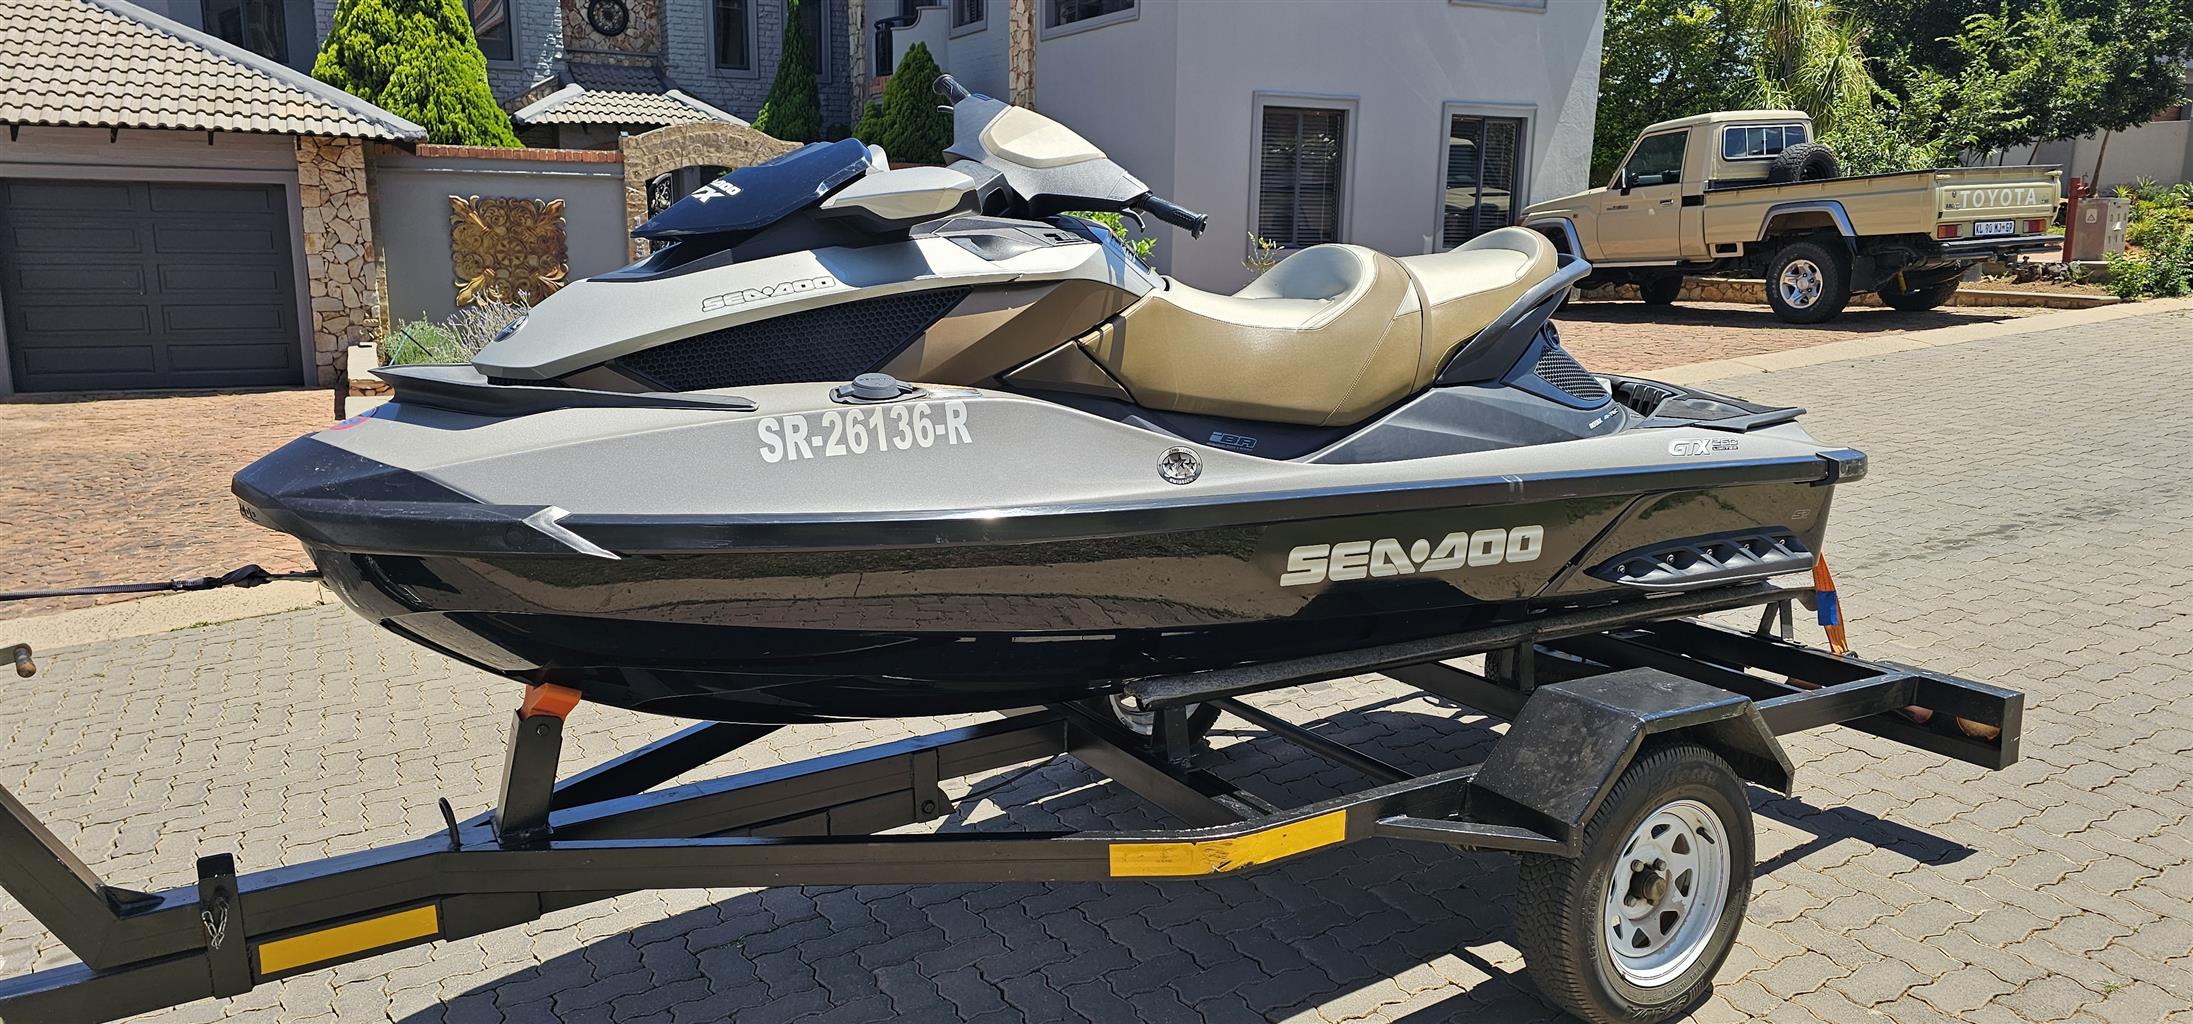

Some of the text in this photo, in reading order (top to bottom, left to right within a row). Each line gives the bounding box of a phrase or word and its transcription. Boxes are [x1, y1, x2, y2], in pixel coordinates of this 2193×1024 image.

[1960, 188, 2037, 209] TOYOTA
[757, 401, 973, 463] SR-26136-R
[1669, 438, 1711, 456] GTX
